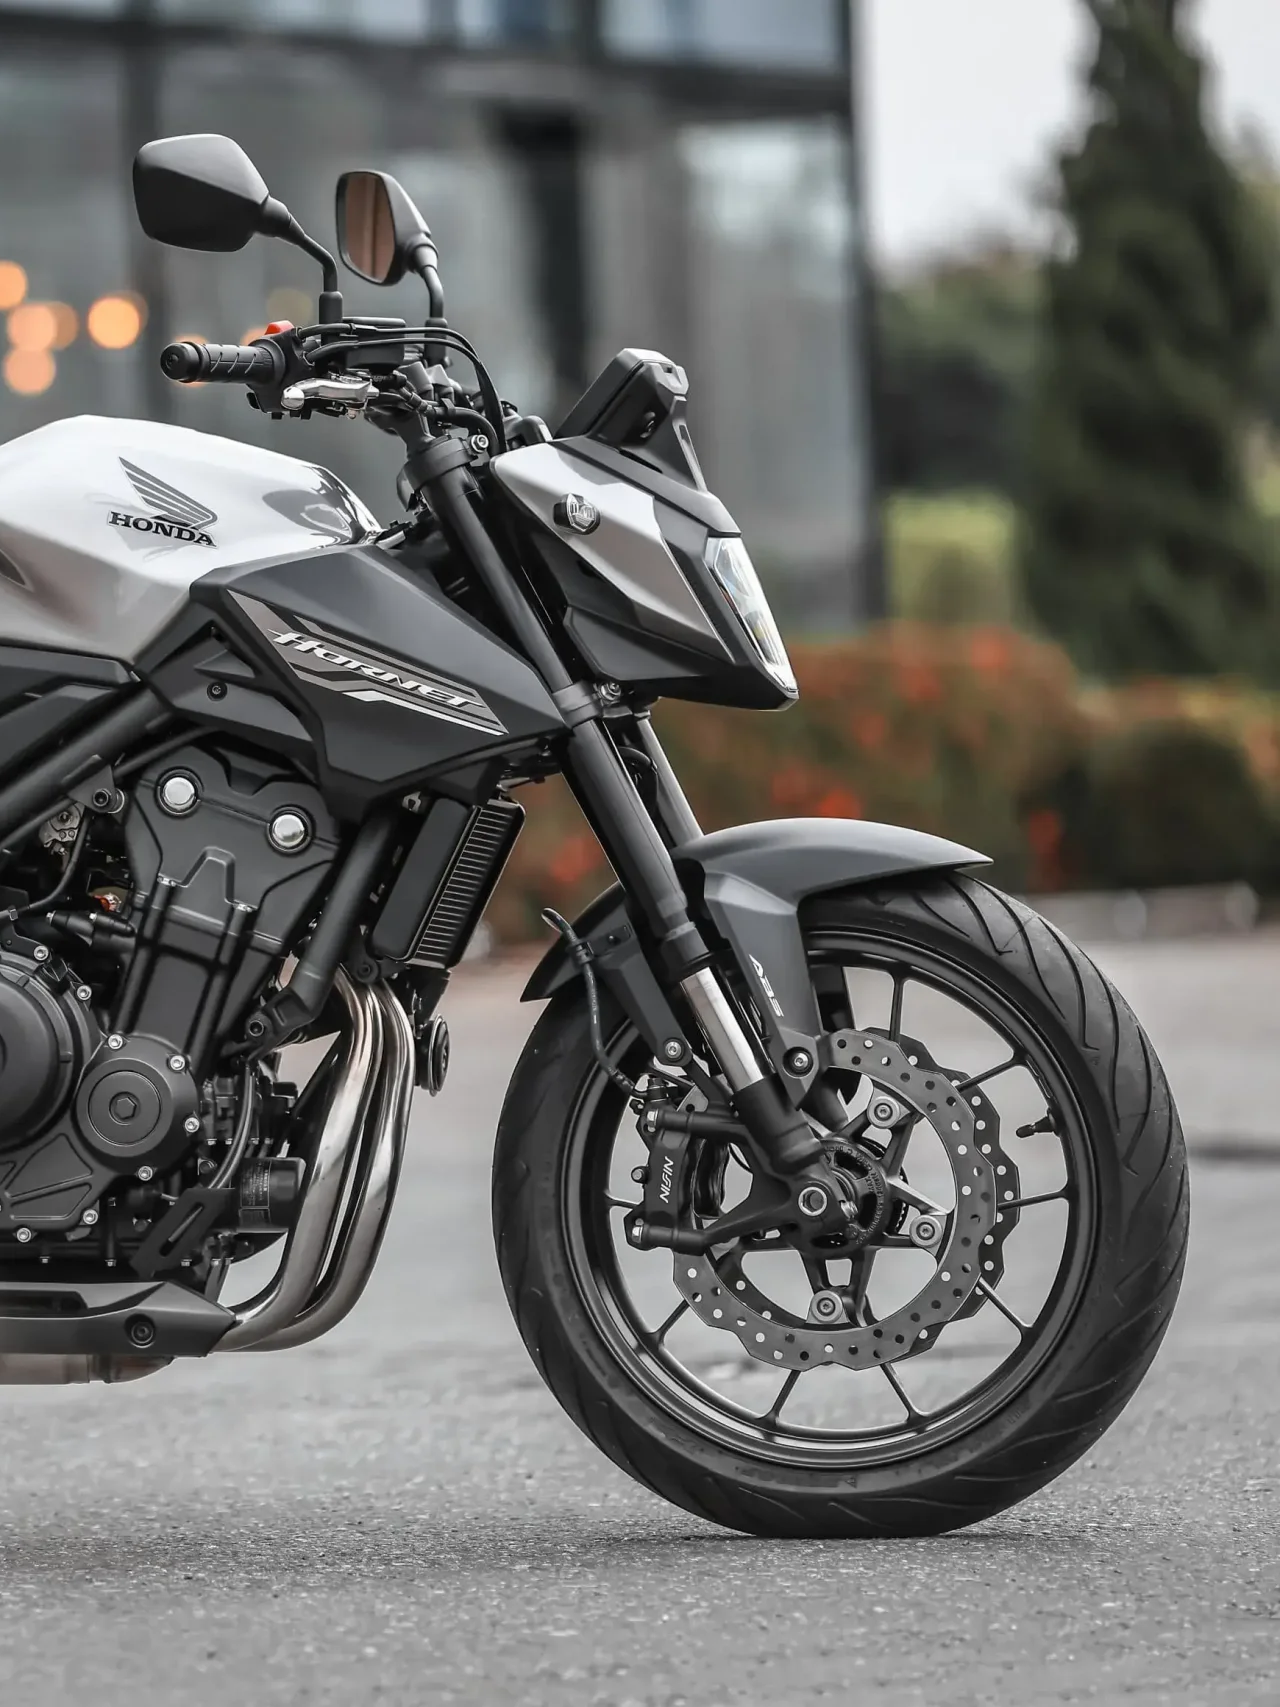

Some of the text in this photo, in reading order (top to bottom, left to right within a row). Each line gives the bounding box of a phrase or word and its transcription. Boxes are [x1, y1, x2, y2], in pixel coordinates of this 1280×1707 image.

[109, 511, 217, 547] HONDA
[267, 628, 487, 709] HORNET
[748, 953, 785, 1017] ABS
[659, 1155, 674, 1204] NISSIN
